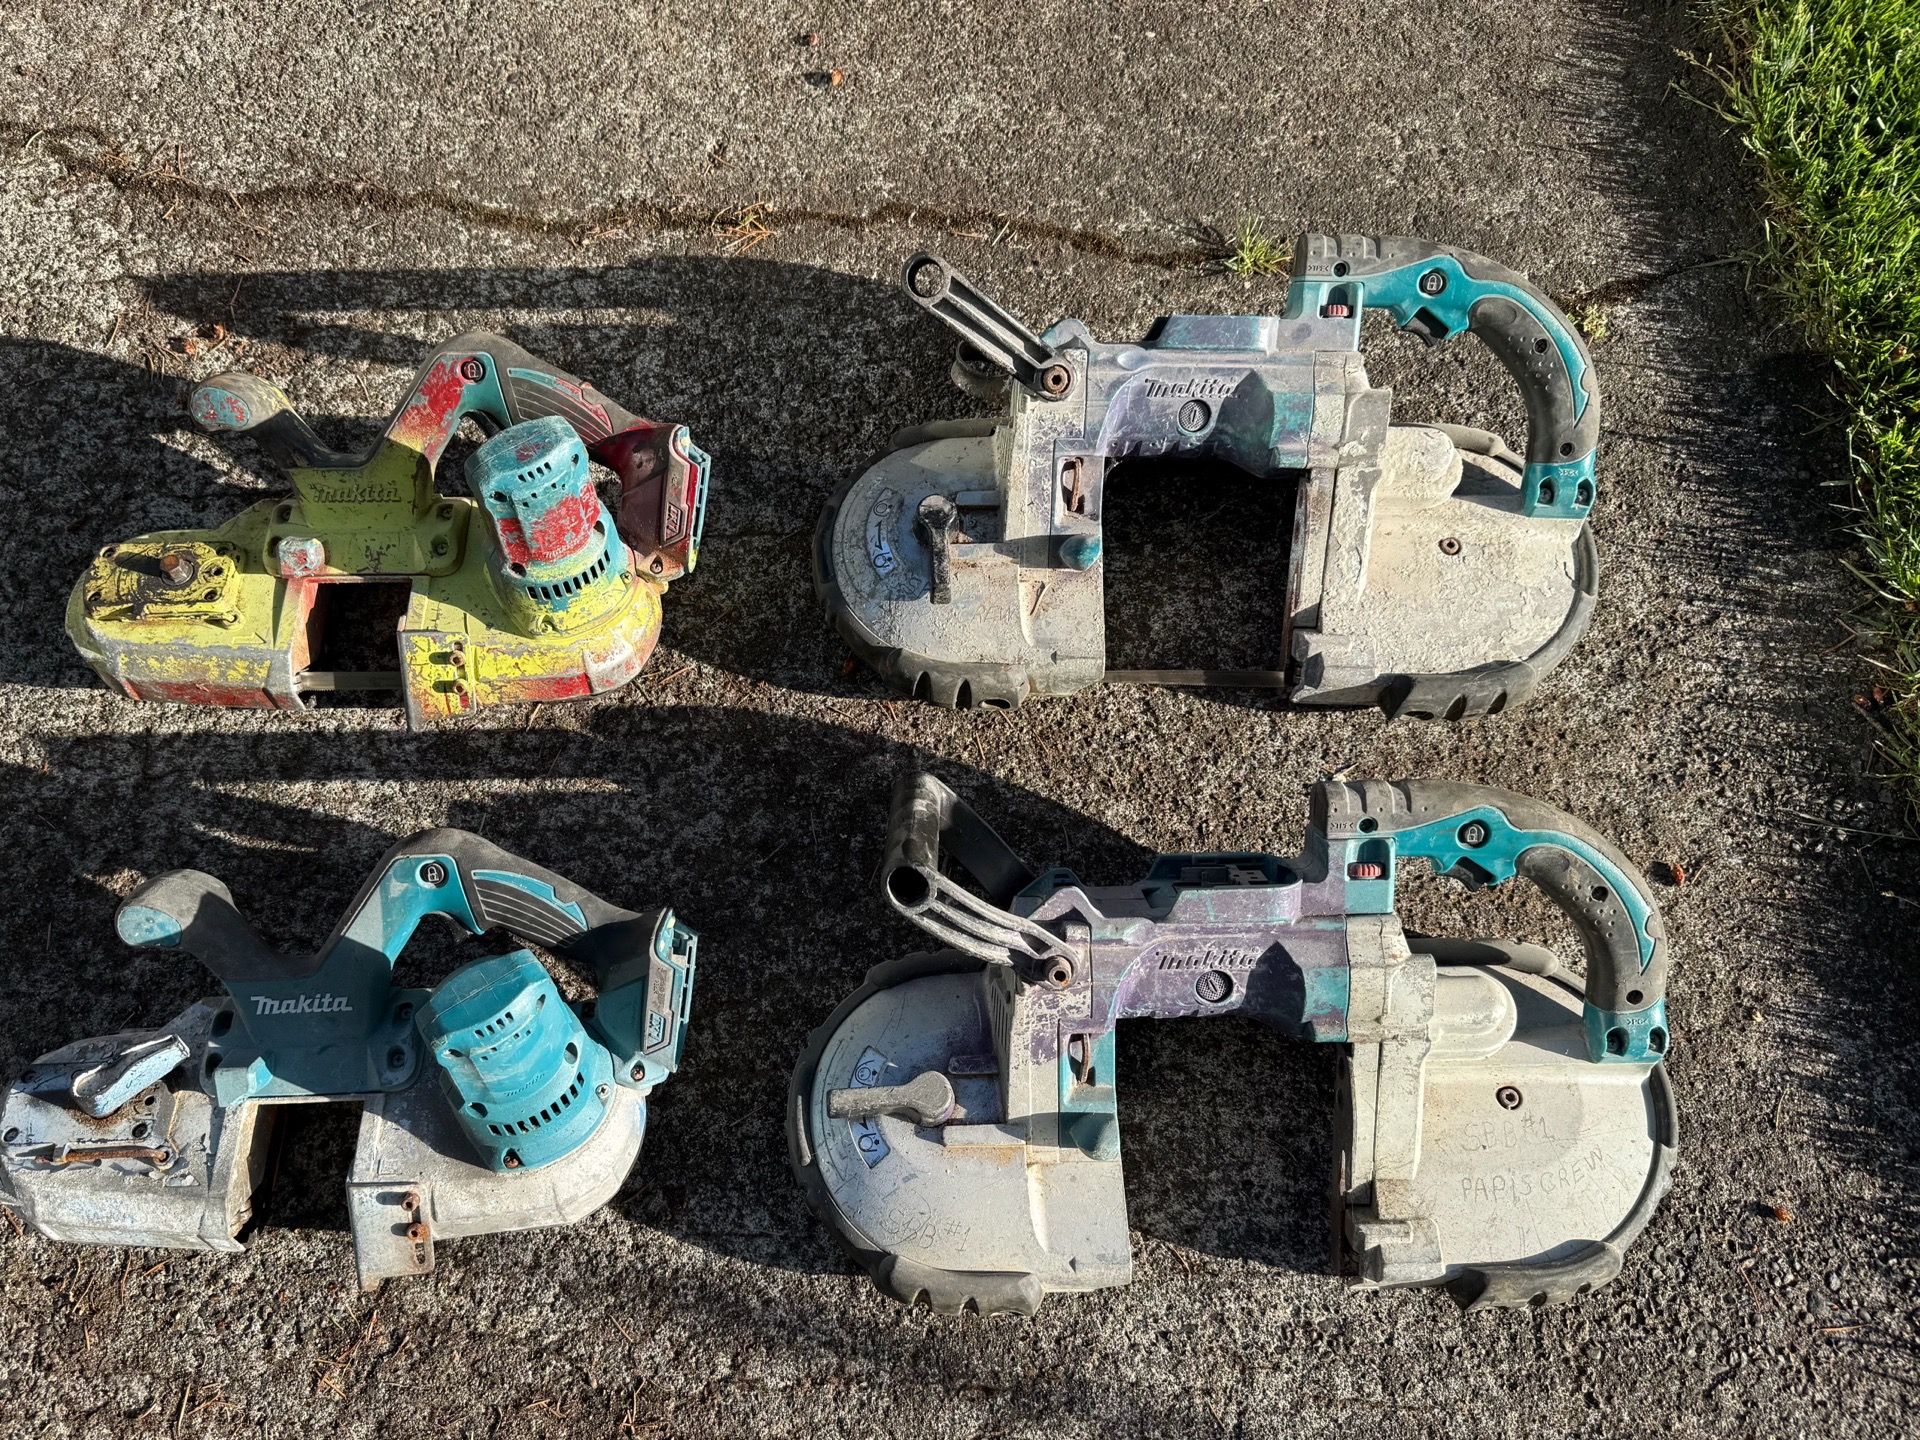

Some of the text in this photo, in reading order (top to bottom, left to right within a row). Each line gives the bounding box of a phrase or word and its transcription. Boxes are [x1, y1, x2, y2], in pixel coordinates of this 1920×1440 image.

[1144, 378, 1241, 398] Makita
[1155, 949, 1258, 971] Makita
[250, 993, 353, 1015] Makita
